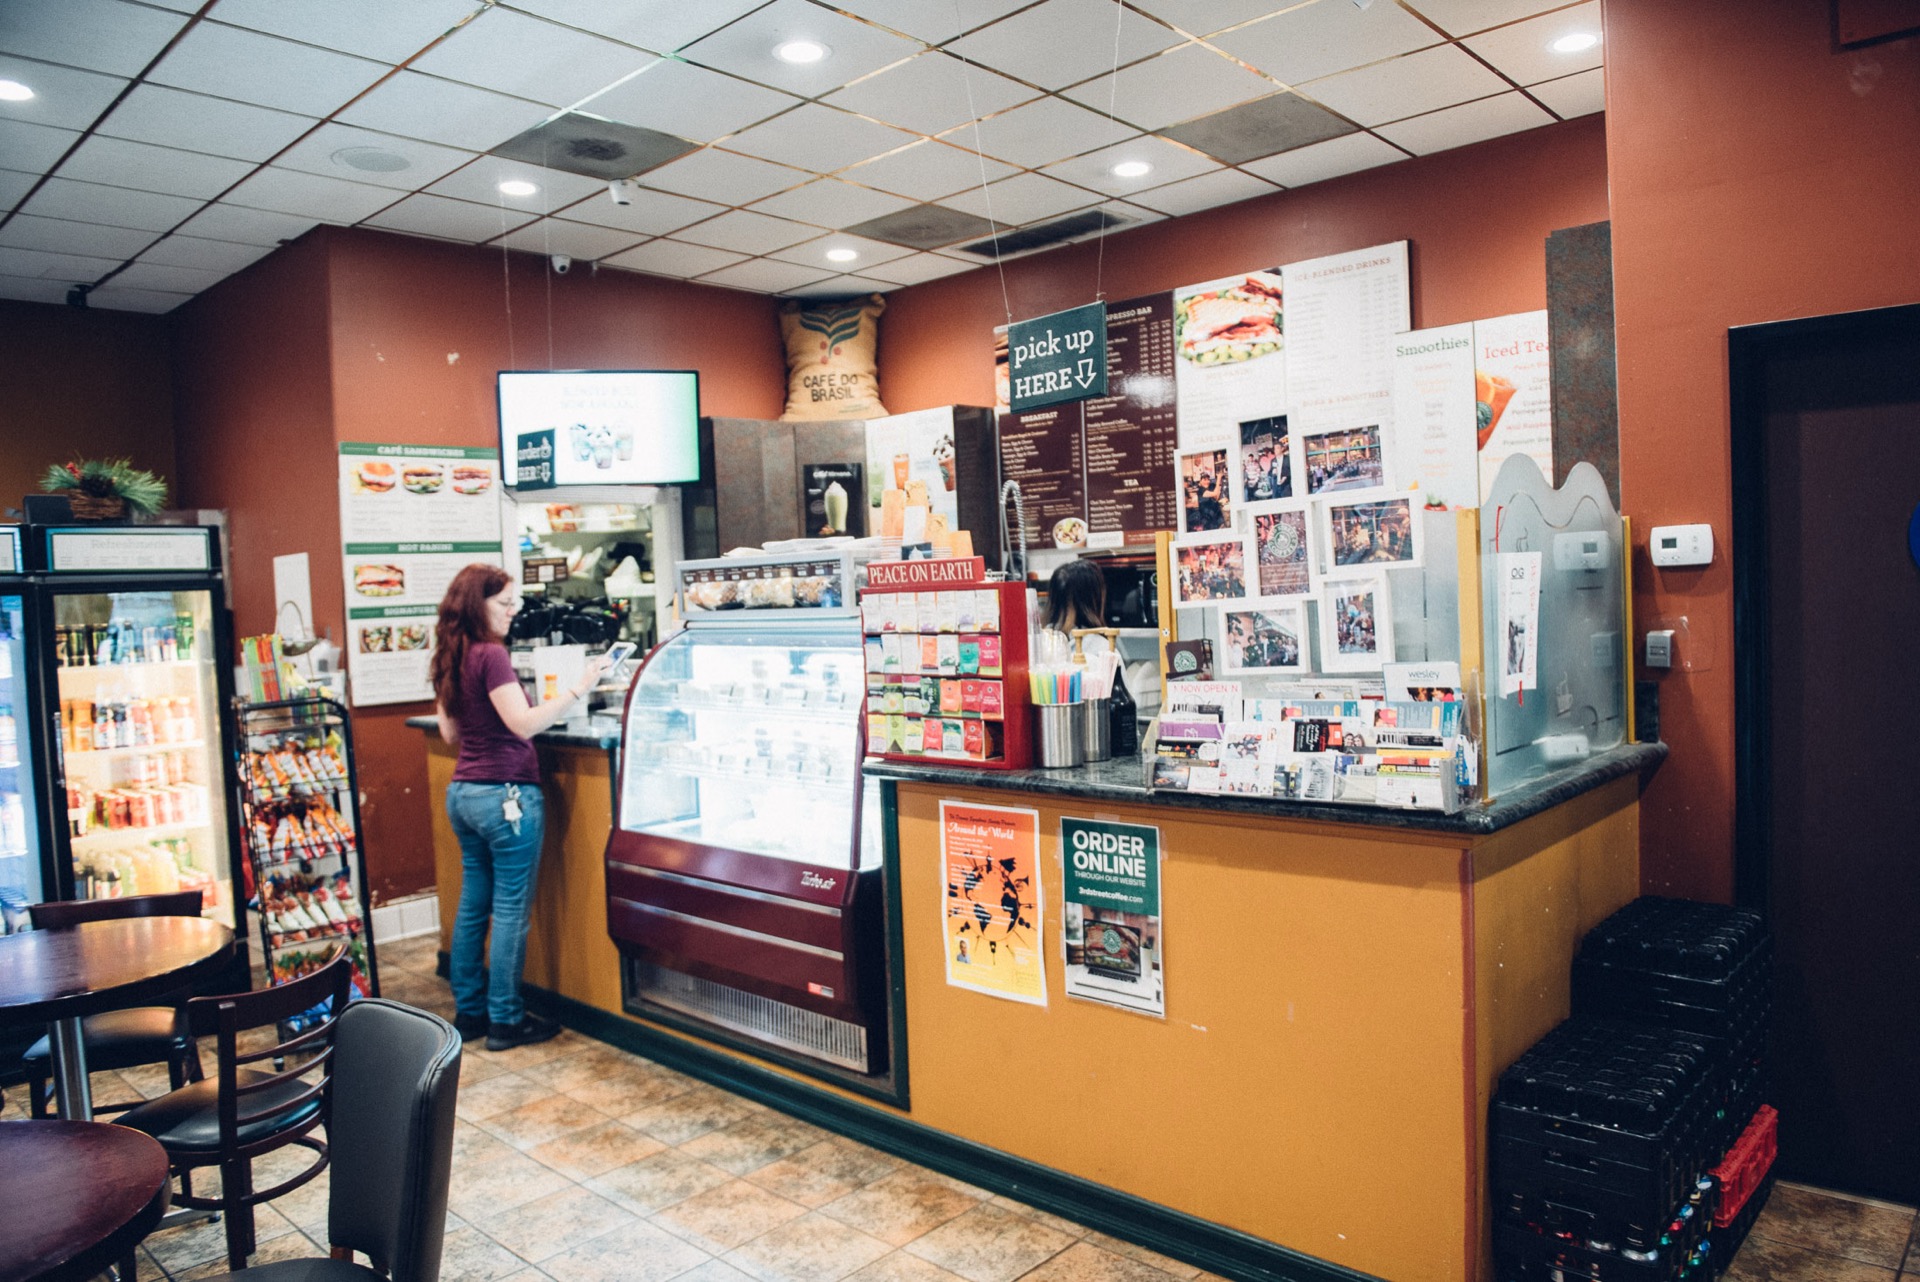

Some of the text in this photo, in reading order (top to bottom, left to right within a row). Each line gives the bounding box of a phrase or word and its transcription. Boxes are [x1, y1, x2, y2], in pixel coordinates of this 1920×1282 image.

[1355, 257, 1392, 271] DRINKS
[1106, 310, 1136, 321] SPRESSO
[1014, 329, 1094, 369] pick up
[1396, 337, 1469, 357] Smoothies
[1485, 340, 1519, 359] Iced
[841, 374, 859, 386] DO
[1015, 367, 1072, 399] HERE
[811, 387, 855, 402] BRASIL
[1020, 411, 1058, 423] BREAKFAST
[1123, 478, 1139, 487] TEA
[869, 561, 974, 584] PEACE ON EARTH
[1407, 669, 1440, 680] wesley
[1180, 684, 1200, 693] NOW
[1203, 684, 1228, 693] OPEN
[947, 822, 1015, 840] Around the World
[1072, 829, 1146, 858] ORDER
[1072, 850, 1147, 879] ONLINE
[1074, 870, 1146, 888] THROUGH OUR WEBSITE
